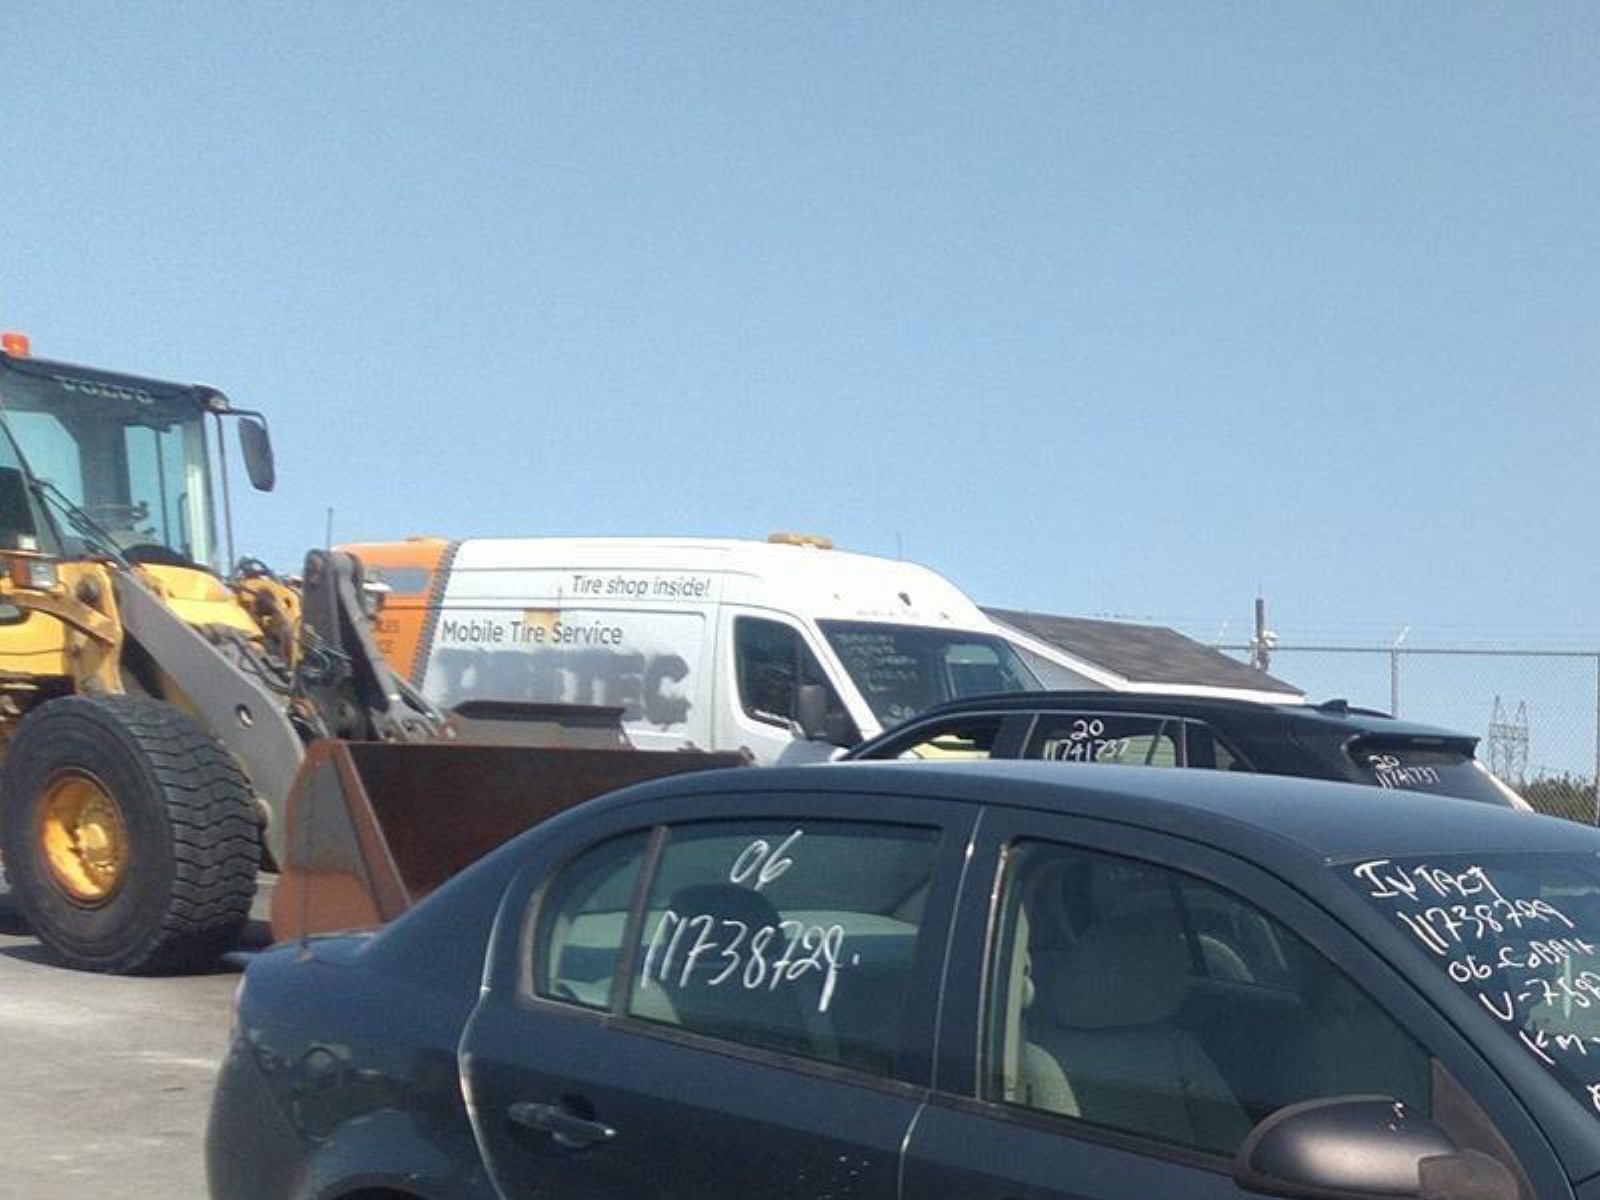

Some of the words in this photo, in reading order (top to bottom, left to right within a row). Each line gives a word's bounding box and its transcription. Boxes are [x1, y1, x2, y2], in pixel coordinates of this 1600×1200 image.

[572, 575, 601, 595] Tire
[606, 576, 648, 598] shop
[653, 577, 712, 597] inside!
[441, 620, 503, 643] Mobile
[510, 621, 544, 643] Tire
[551, 621, 624, 644] Service
[1070, 719, 1104, 740] 20
[1369, 754, 1400, 770] 20
[730, 829, 803, 890] 06
